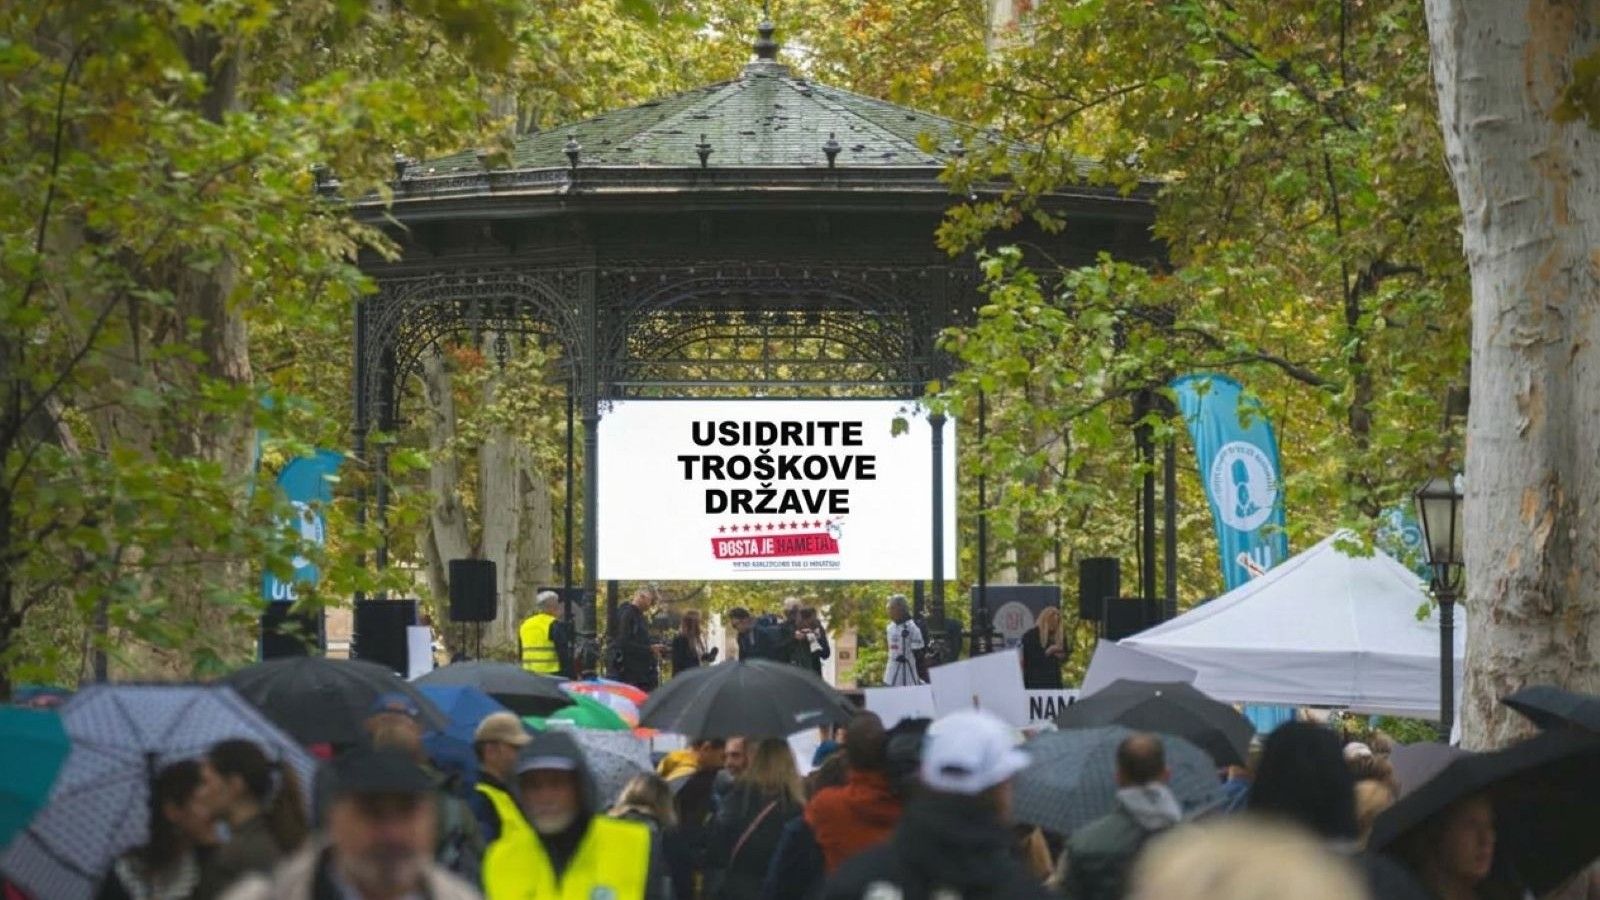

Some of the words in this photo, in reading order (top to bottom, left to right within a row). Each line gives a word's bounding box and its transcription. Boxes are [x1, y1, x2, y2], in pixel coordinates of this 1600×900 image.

[692, 421, 863, 446] USIDRITE
[678, 448, 877, 481] TROŠKOVE
[705, 482, 850, 515] DRŽAVE
[718, 538, 759, 557] DOSTA
[760, 536, 775, 555] JE
